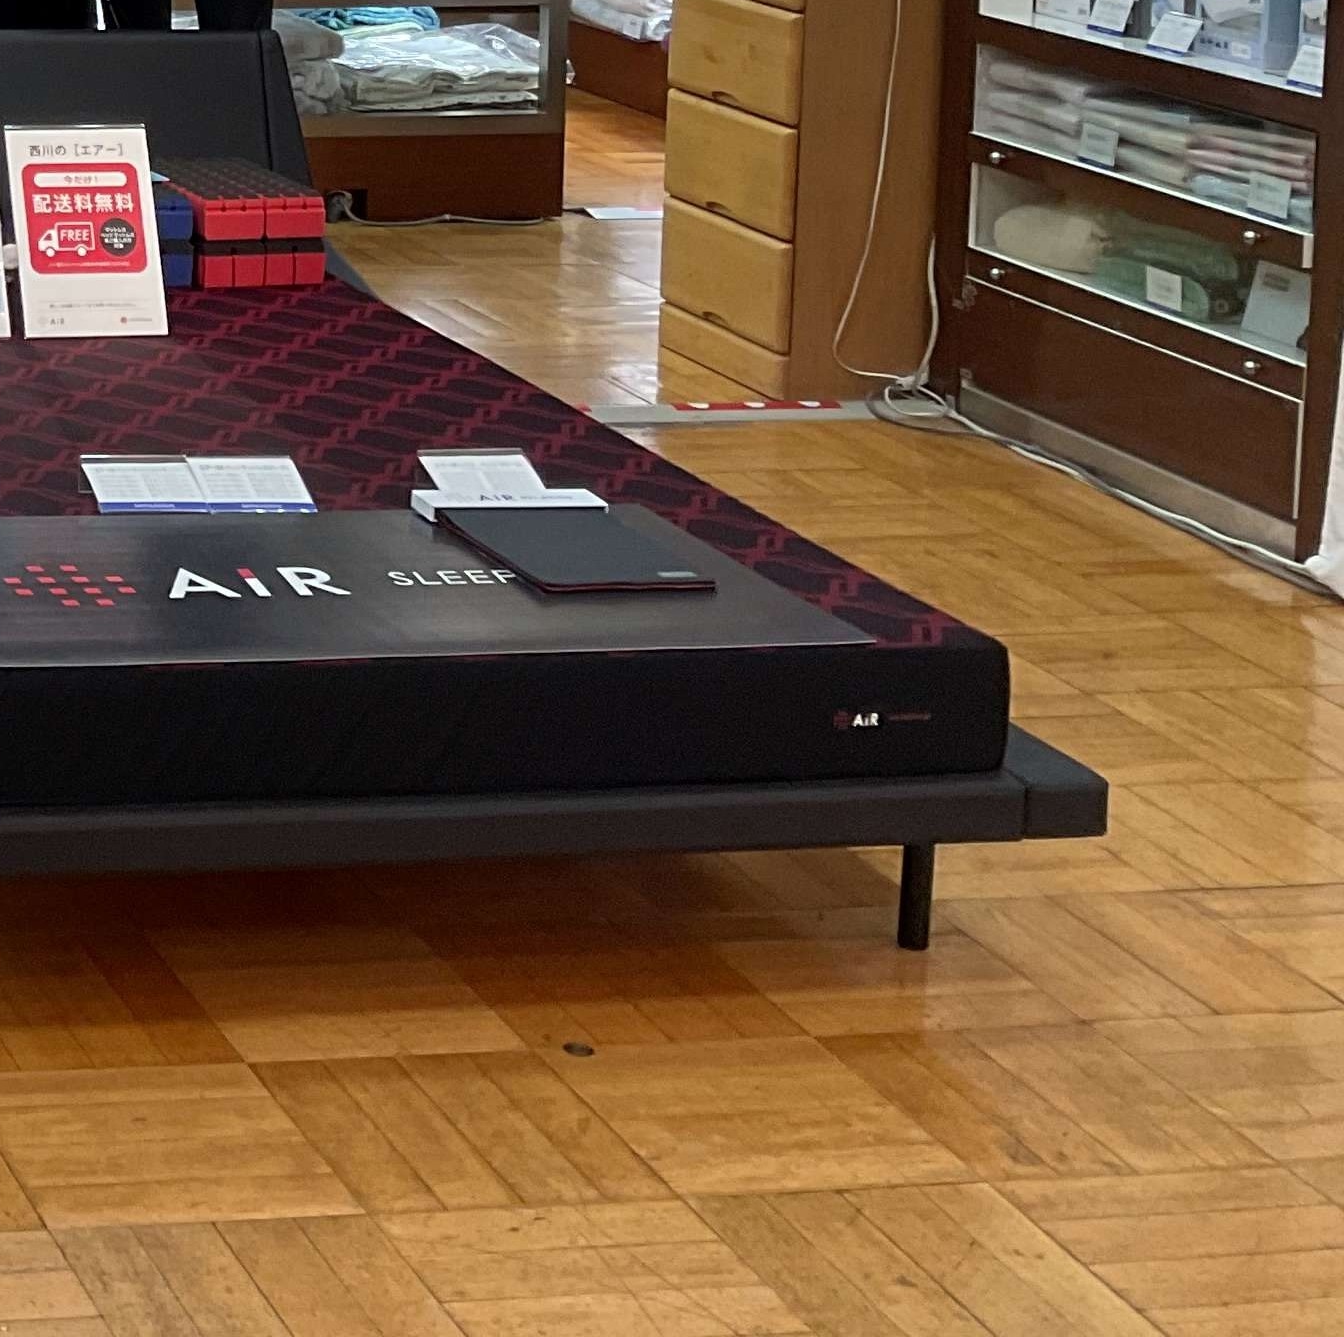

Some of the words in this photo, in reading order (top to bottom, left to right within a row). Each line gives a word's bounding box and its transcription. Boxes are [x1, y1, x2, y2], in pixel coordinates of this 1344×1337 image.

[31, 192, 135, 214] 配送料無料
[60, 228, 90, 242] FREE
